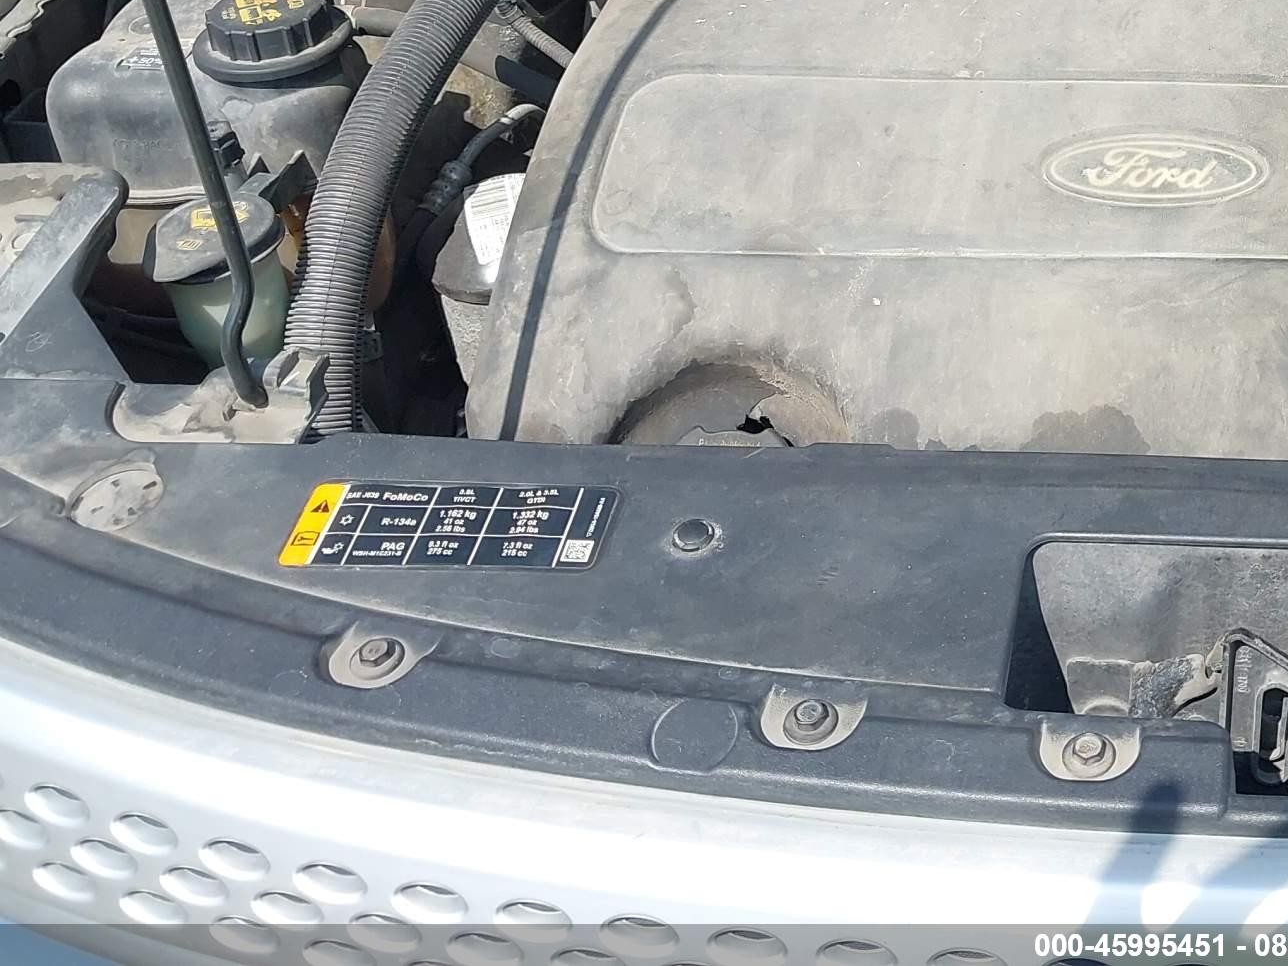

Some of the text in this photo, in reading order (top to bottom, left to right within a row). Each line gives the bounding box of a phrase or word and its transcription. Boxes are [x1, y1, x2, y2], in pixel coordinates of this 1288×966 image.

[1082, 147, 1217, 189] Ford
[382, 492, 429, 501] FoMoCo
[439, 509, 477, 520] 1.162 kg
[537, 510, 550, 520] kg
[380, 517, 417, 526] R-134a
[453, 525, 466, 533] lbs
[526, 526, 539, 534] lbs
[381, 542, 406, 550] PAG
